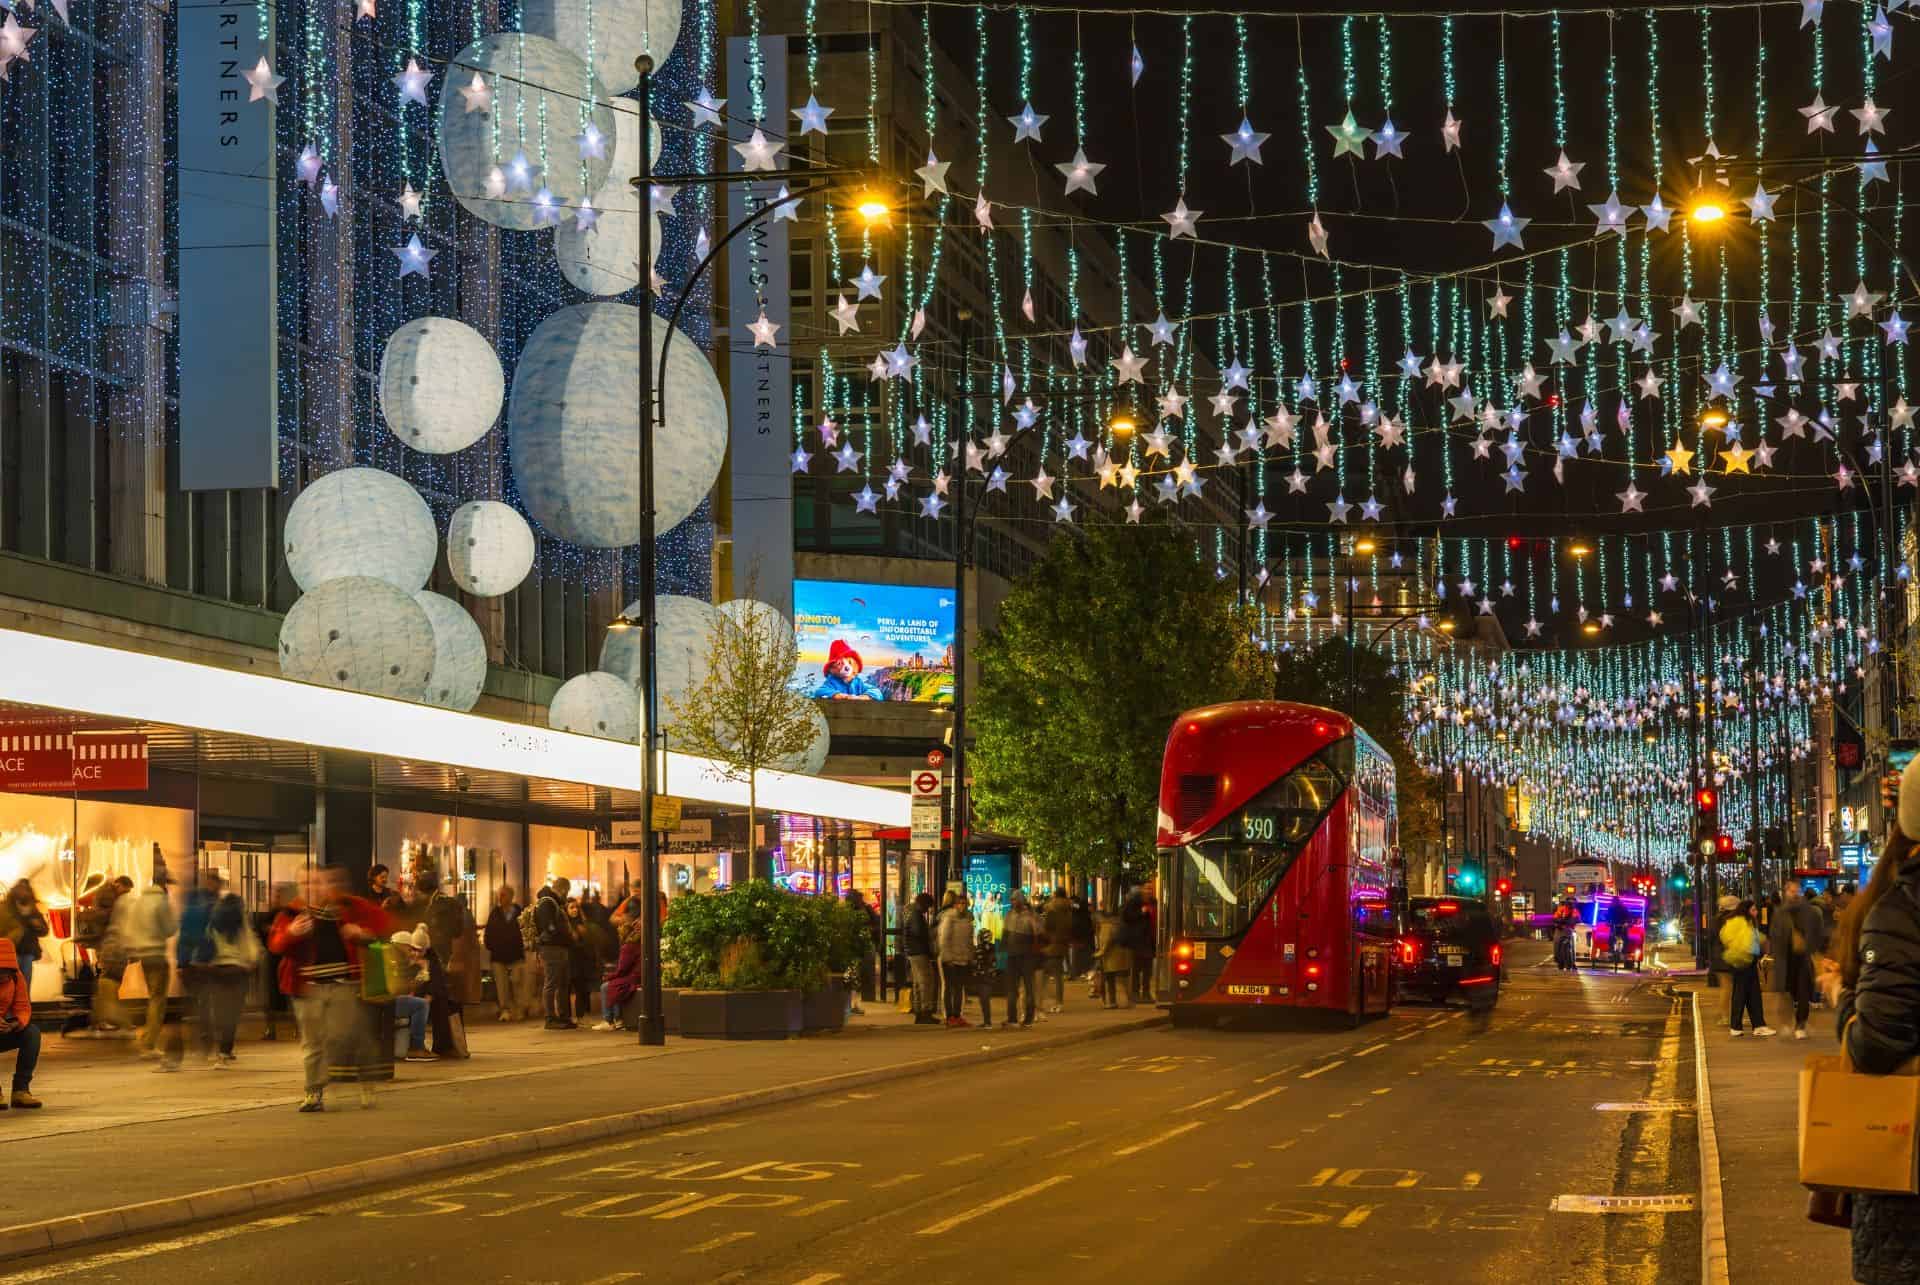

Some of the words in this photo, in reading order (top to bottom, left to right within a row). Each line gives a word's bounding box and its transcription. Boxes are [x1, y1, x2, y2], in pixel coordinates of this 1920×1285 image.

[219, 0, 239, 146] RTNERS
[743, 57, 767, 139] JOH
[748, 196, 769, 288] EWIS
[757, 349, 771, 435] RTNERS
[1245, 818, 1273, 840] 390
[966, 873, 993, 884] BAD
[358, 1192, 803, 1221] STOP
